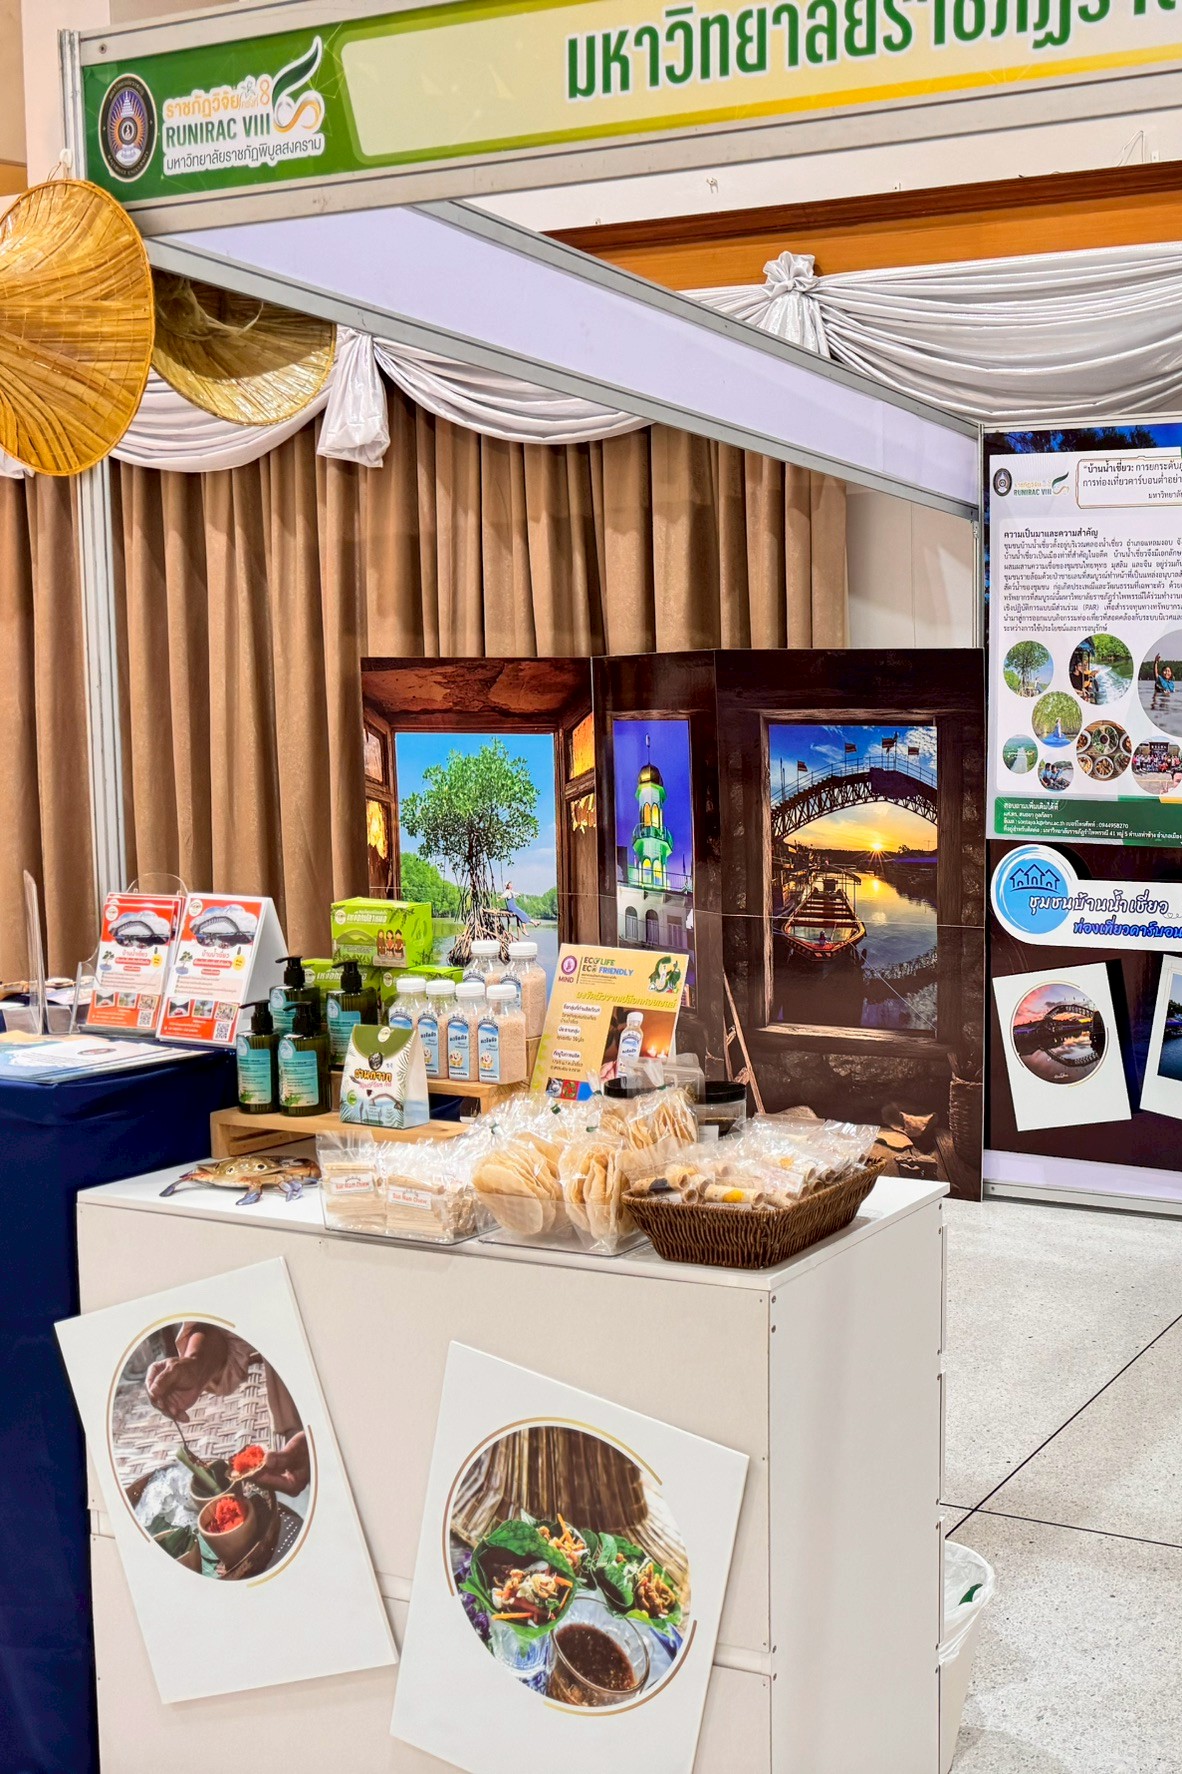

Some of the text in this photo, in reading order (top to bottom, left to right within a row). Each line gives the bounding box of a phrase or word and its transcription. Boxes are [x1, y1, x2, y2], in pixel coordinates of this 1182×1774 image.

[166, 91, 240, 118] ราชภัฏวิจัย
[166, 113, 270, 148] RUNIRAC VIII
[166, 137, 322, 170] มหาวิทยาลัยราชภัฏพิบูลสงคราม
[1028, 889, 1169, 915] ชุมชนบ้านน้ำเชี่ยว
[599, 967, 634, 976] FRIENDLY
